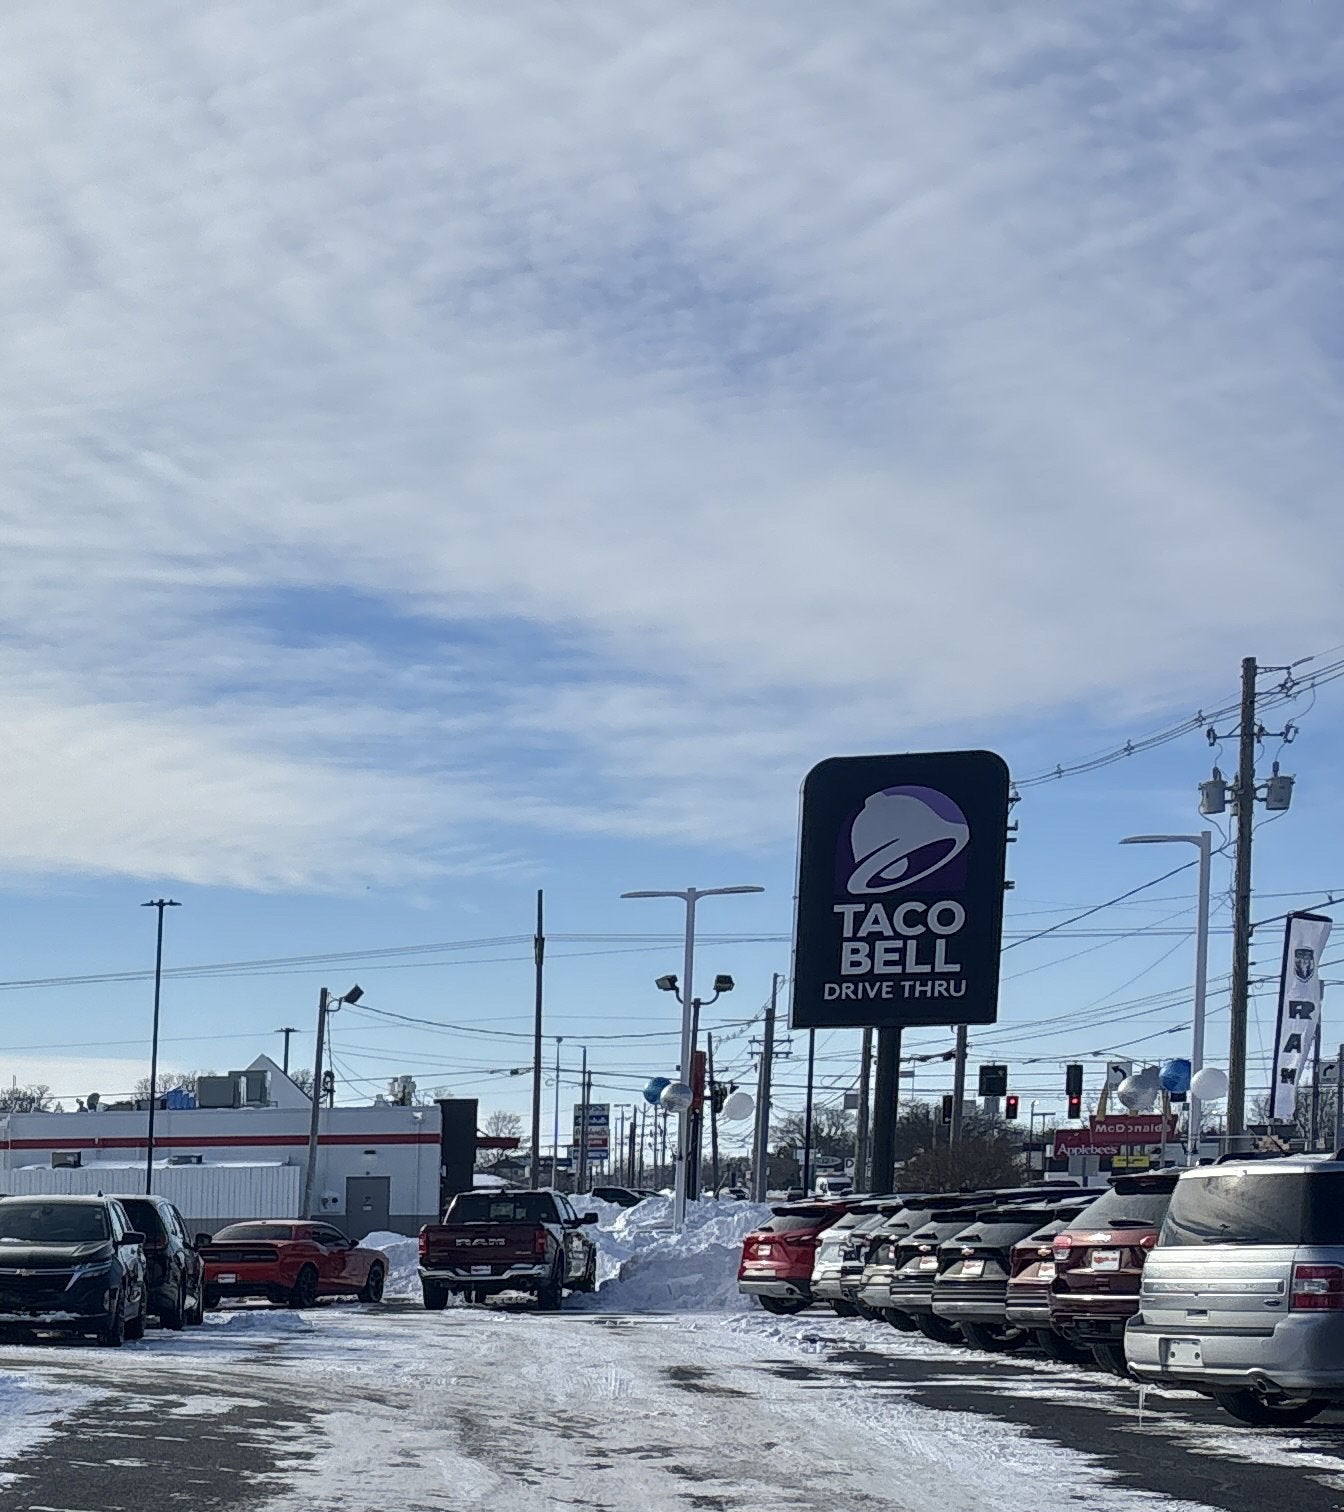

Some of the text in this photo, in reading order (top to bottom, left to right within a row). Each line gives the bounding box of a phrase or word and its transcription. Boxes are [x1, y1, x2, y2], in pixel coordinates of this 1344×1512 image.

[833, 900, 966, 937] TACO
[840, 938, 962, 976] BELL
[823, 979, 967, 1001] DRIVE THRU
[1280, 1000, 1316, 1086] RAM
[455, 1238, 506, 1248] RAM
